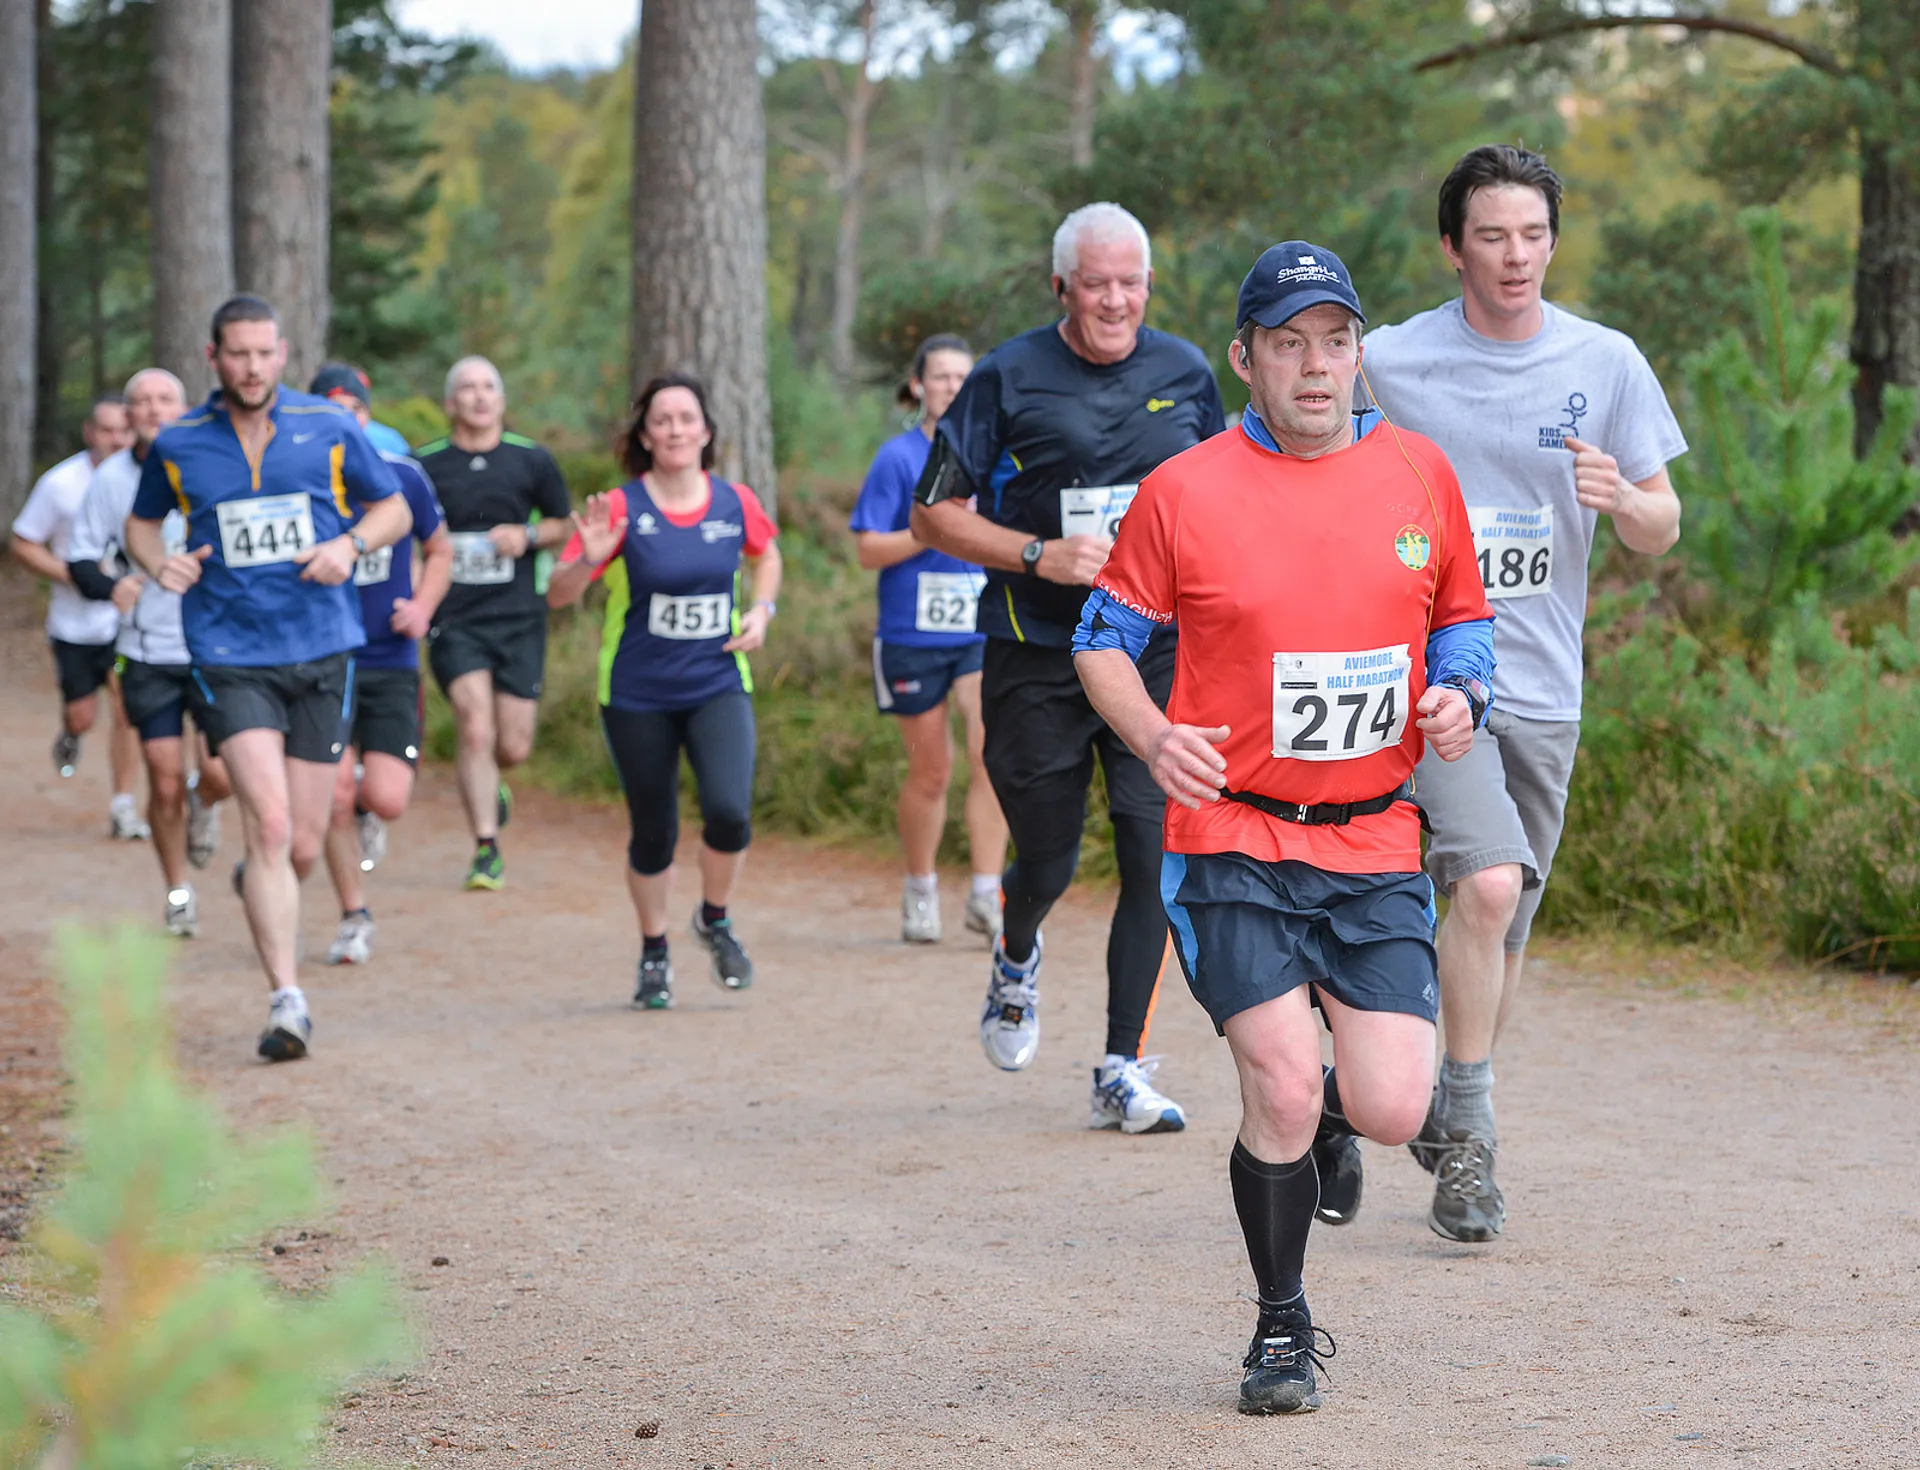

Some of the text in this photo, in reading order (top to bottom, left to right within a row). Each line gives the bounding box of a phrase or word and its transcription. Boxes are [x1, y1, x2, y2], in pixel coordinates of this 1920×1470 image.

[1539, 427, 1561, 437] KIDS
[234, 519, 303, 556] 444
[1481, 527, 1502, 538] HALF
[1478, 546, 1549, 589] 186
[660, 601, 720, 631] 451
[928, 596, 978, 625] 62
[1344, 651, 1393, 670] AVIEMORE
[1327, 667, 1404, 689] HALF MARATHON
[1291, 687, 1396, 751] 274
